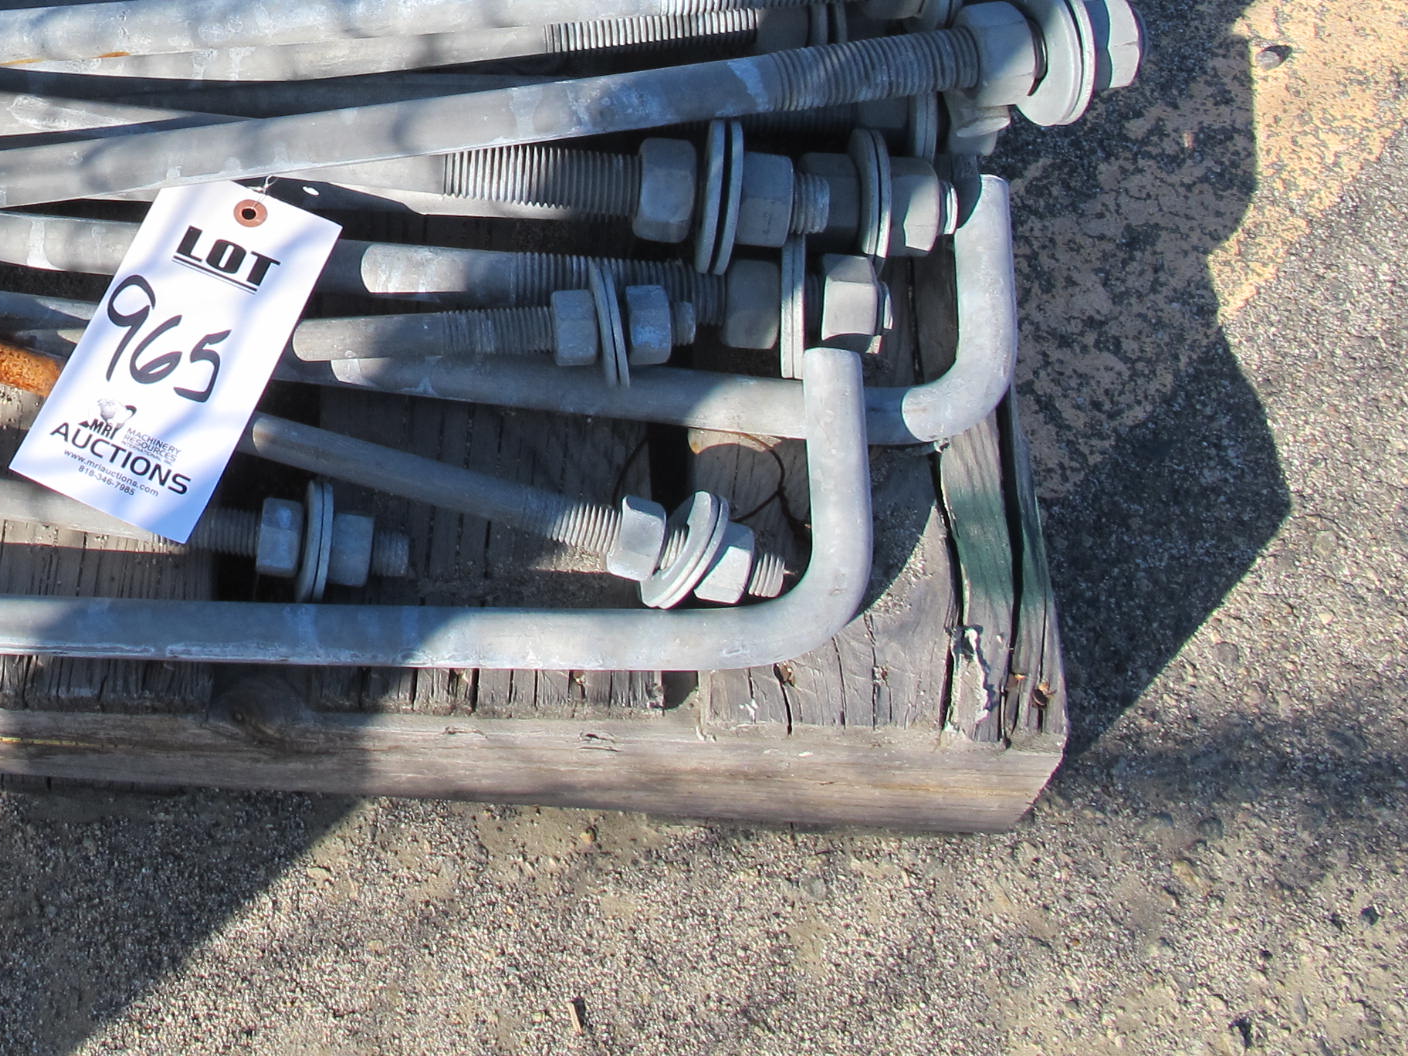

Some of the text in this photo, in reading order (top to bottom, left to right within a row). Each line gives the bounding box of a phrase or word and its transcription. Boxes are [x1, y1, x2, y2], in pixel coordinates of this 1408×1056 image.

[177, 225, 280, 286] LOT
[107, 274, 232, 403] 965
[87, 418, 119, 440] MRI
[123, 434, 177, 462] RESOURCES
[126, 427, 182, 455] MACHINERY
[50, 422, 191, 495] AUCTIONS
[64, 449, 159, 496] www.mriauctions.com
